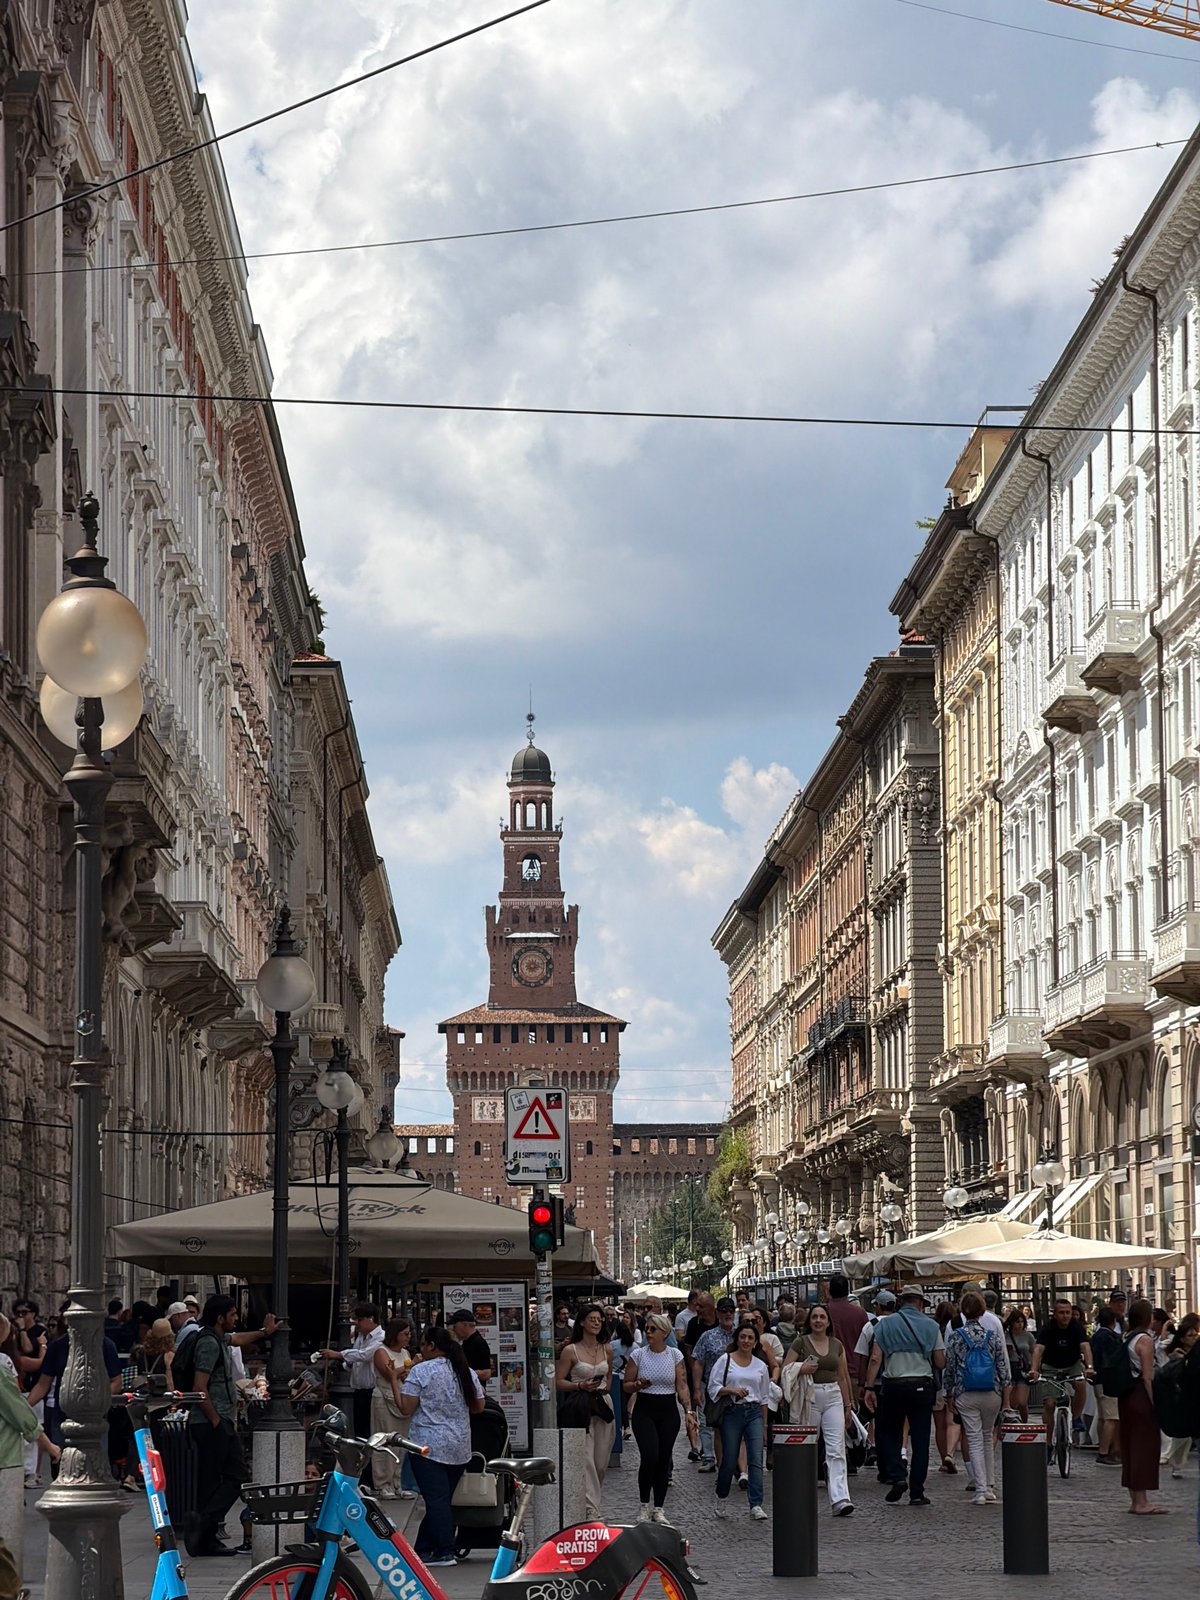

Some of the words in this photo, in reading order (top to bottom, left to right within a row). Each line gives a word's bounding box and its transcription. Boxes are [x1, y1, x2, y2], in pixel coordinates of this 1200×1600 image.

[358, 1203, 427, 1215] Rock
[502, 1241, 516, 1249] Rock
[574, 1528, 610, 1541] PROVA
[556, 1540, 598, 1554] GRATIS!
